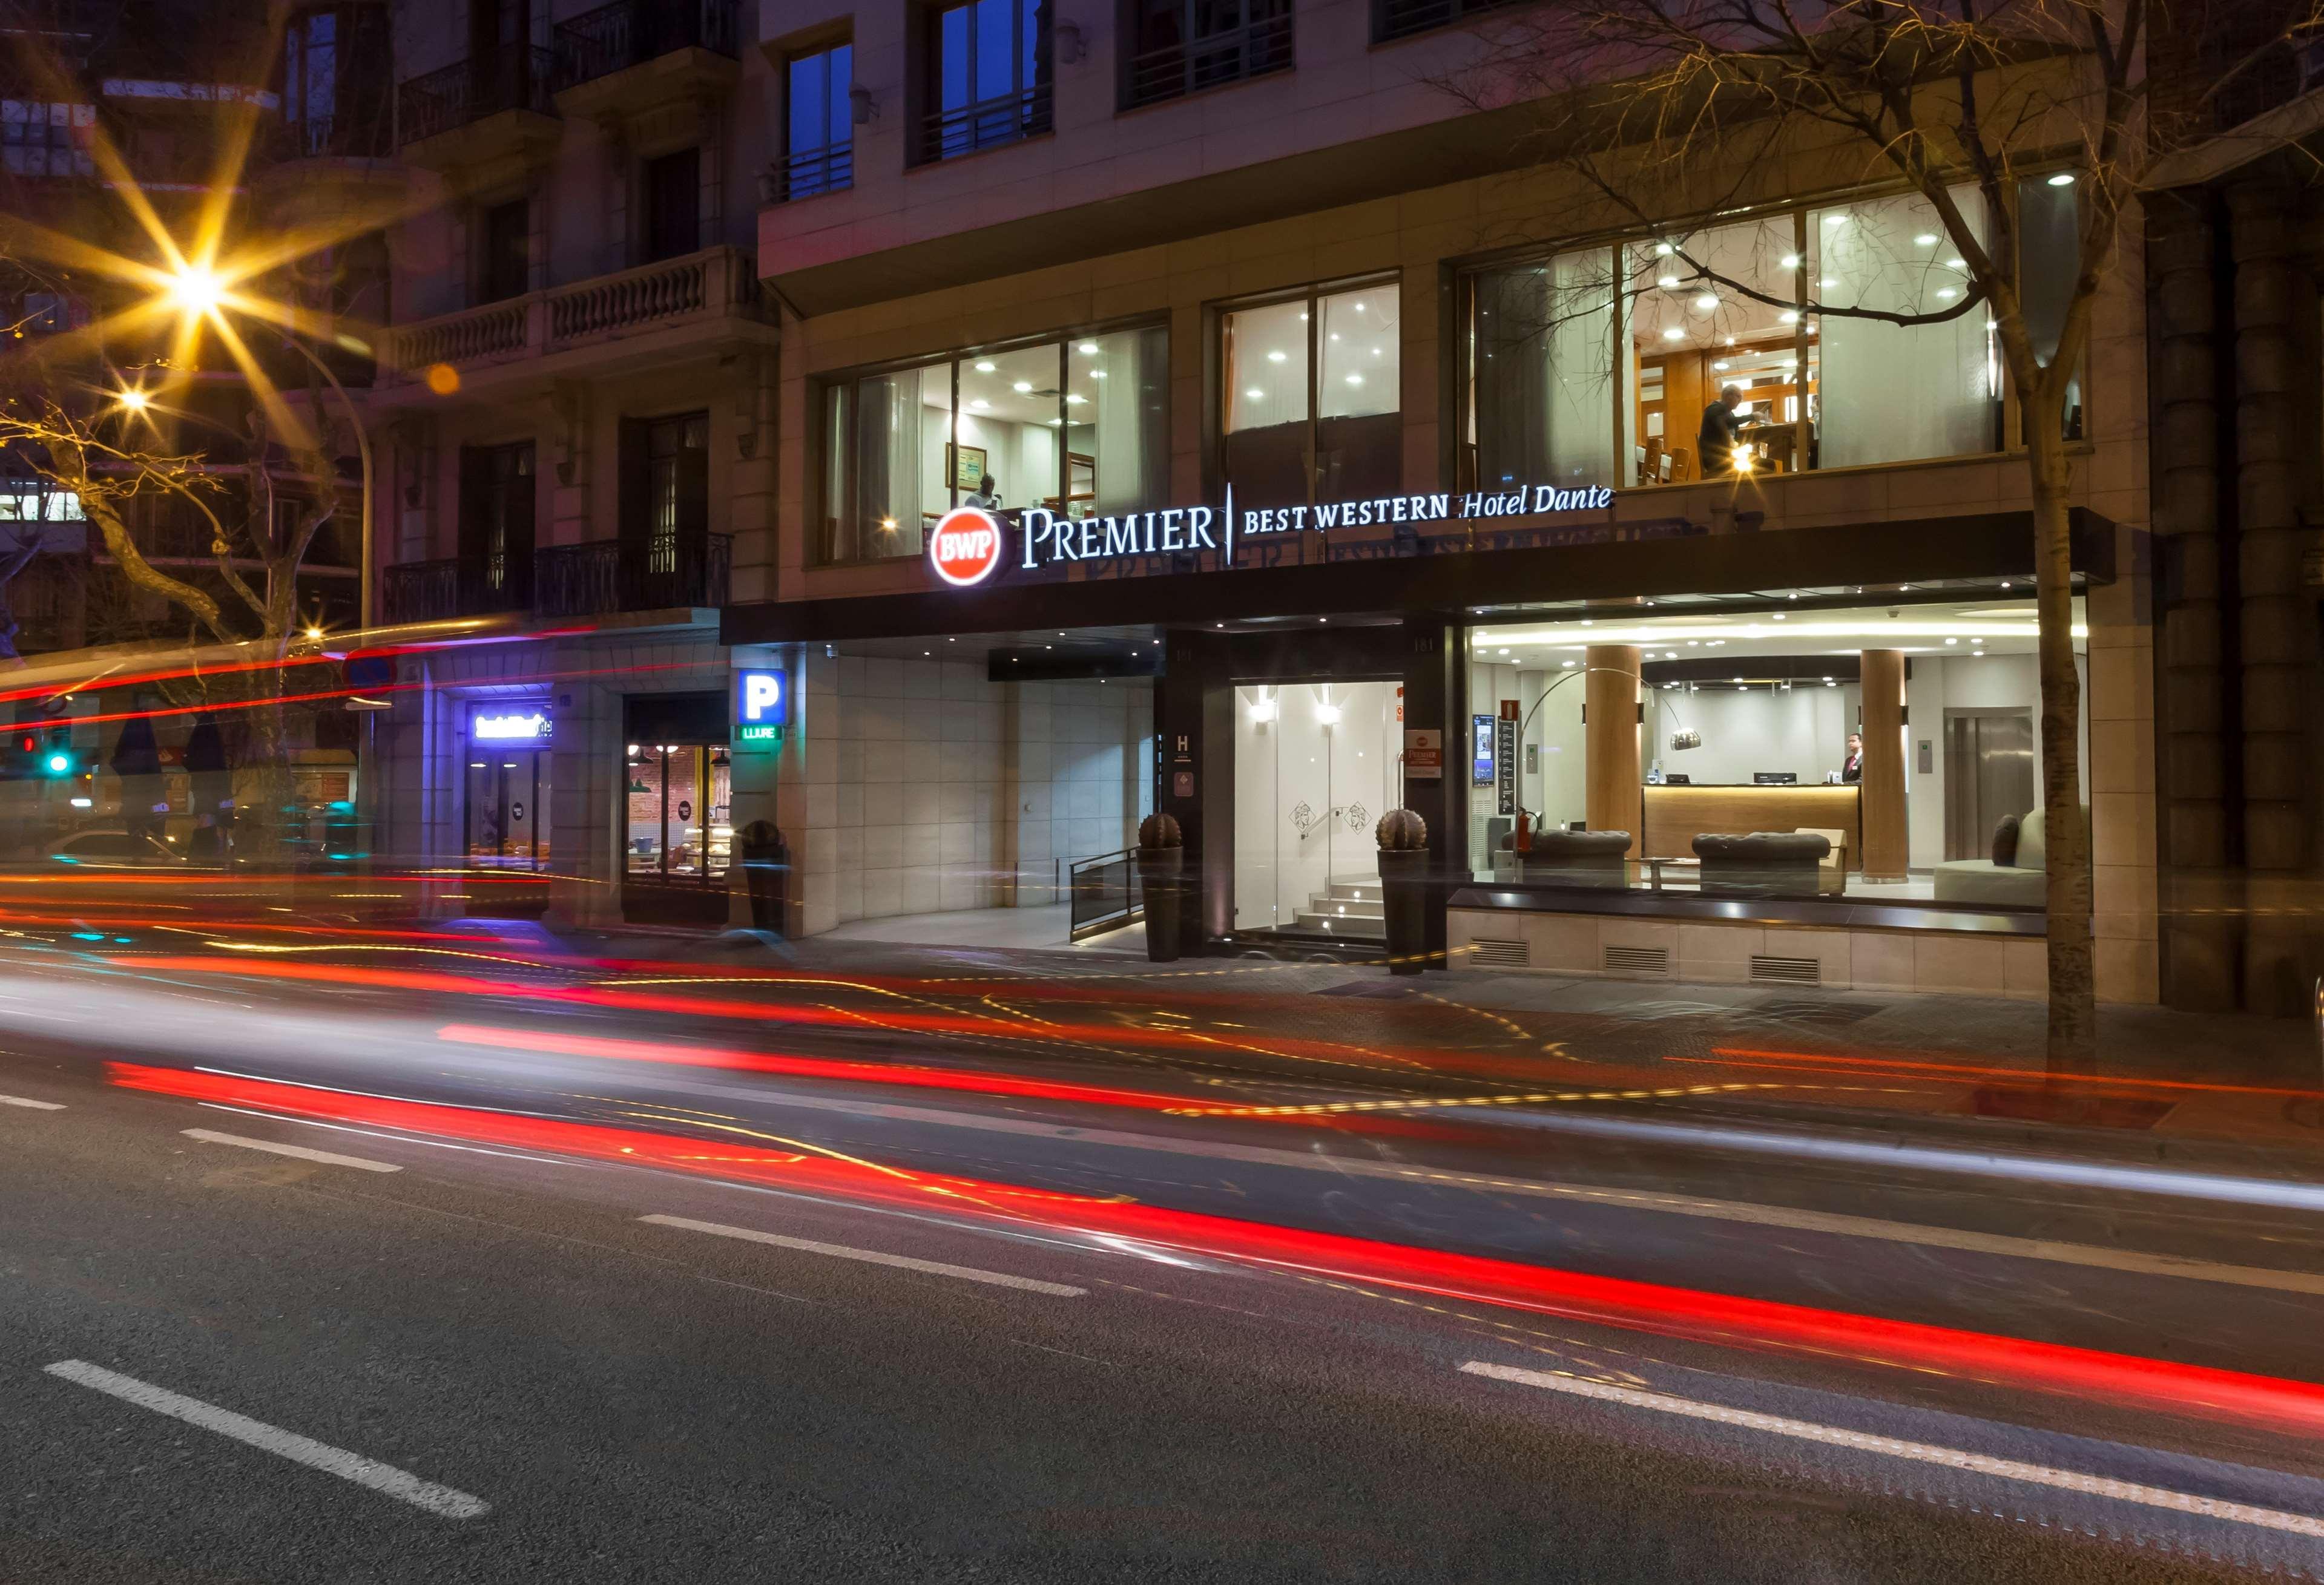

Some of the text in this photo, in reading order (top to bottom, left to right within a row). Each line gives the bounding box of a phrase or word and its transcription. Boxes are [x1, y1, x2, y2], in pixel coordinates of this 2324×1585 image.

[1021, 484, 1612, 569] PREMIER BEST WESTERN Hotel Dante
[940, 530, 992, 562] BWP
[746, 675, 779, 719] P
[1177, 735, 1188, 752] H
